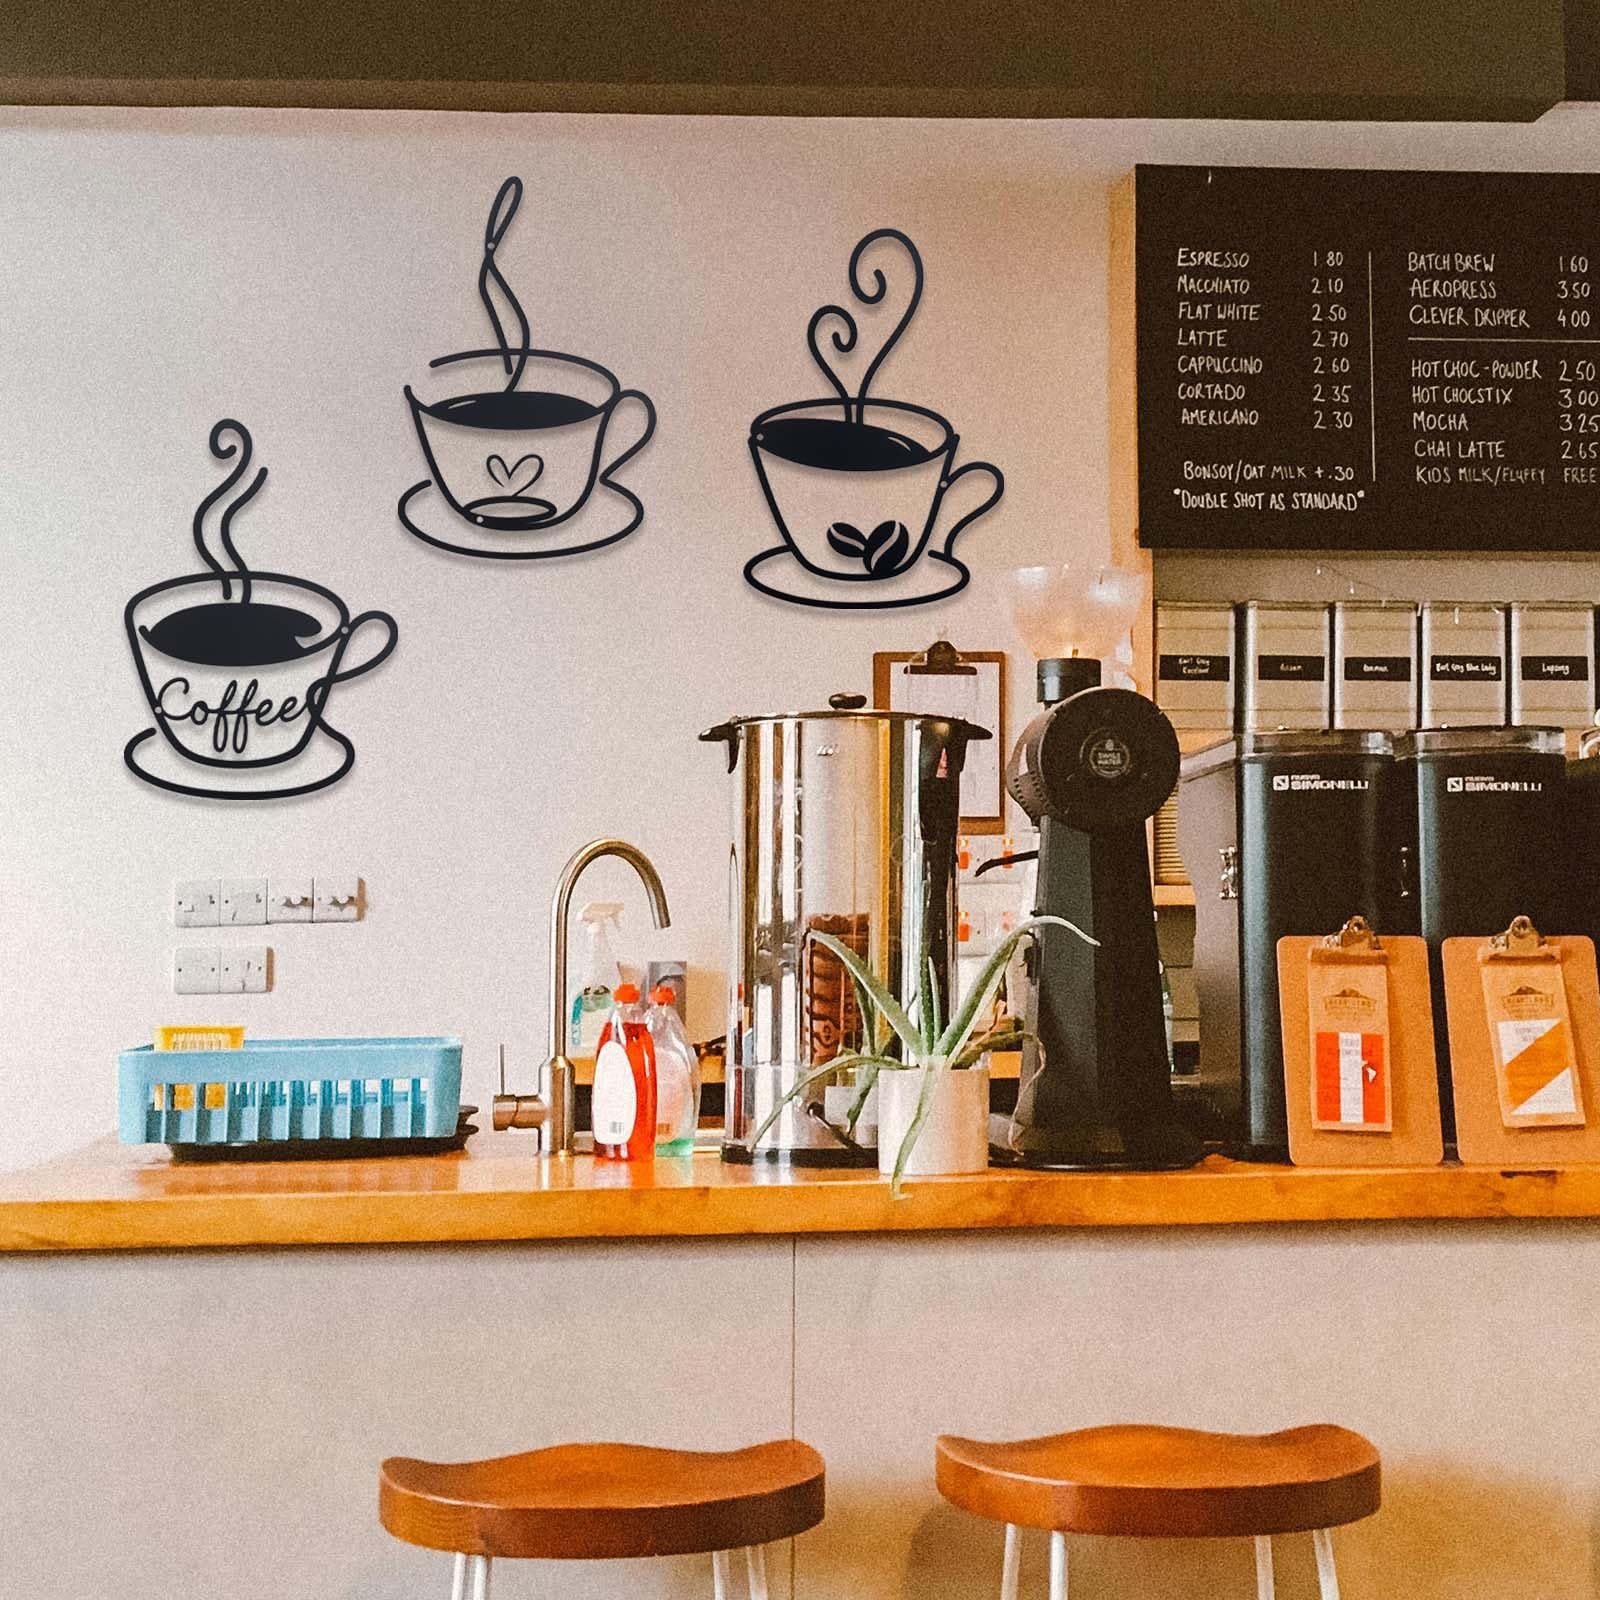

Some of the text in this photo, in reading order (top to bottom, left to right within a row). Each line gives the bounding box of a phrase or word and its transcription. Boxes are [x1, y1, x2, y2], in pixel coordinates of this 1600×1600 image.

[1176, 247, 1250, 268] ESPRESSO
[1408, 251, 1450, 272] BATCH
[1454, 252, 1496, 273] BREW
[1177, 273, 1250, 295] MACCHIATO
[1409, 278, 1497, 300] AEROPRESS
[1178, 301, 1213, 320] FLAT
[1217, 303, 1261, 321] WHITE
[1409, 304, 1469, 326] CLEVER
[1474, 307, 1531, 329] DRIPPER
[1177, 327, 1228, 347] LATTE
[1177, 355, 1263, 375] CAPPUCCINO
[1411, 359, 1441, 378] HOT
[1177, 382, 1246, 401] CORTADO
[1411, 385, 1440, 404] HOT
[1181, 407, 1259, 426] AMERICANO
[1412, 410, 1469, 432] MOCHA
[1414, 439, 1451, 457] CHAI
[1458, 440, 1505, 459] LATTE
[1270, 465, 1307, 481] MILK
[1416, 465, 1451, 485] KIDS
[1563, 467, 1597, 484] FREE
[1232, 491, 1265, 510] SHOT
[1269, 492, 1286, 511] AS
[157, 676, 304, 755] Coffee
